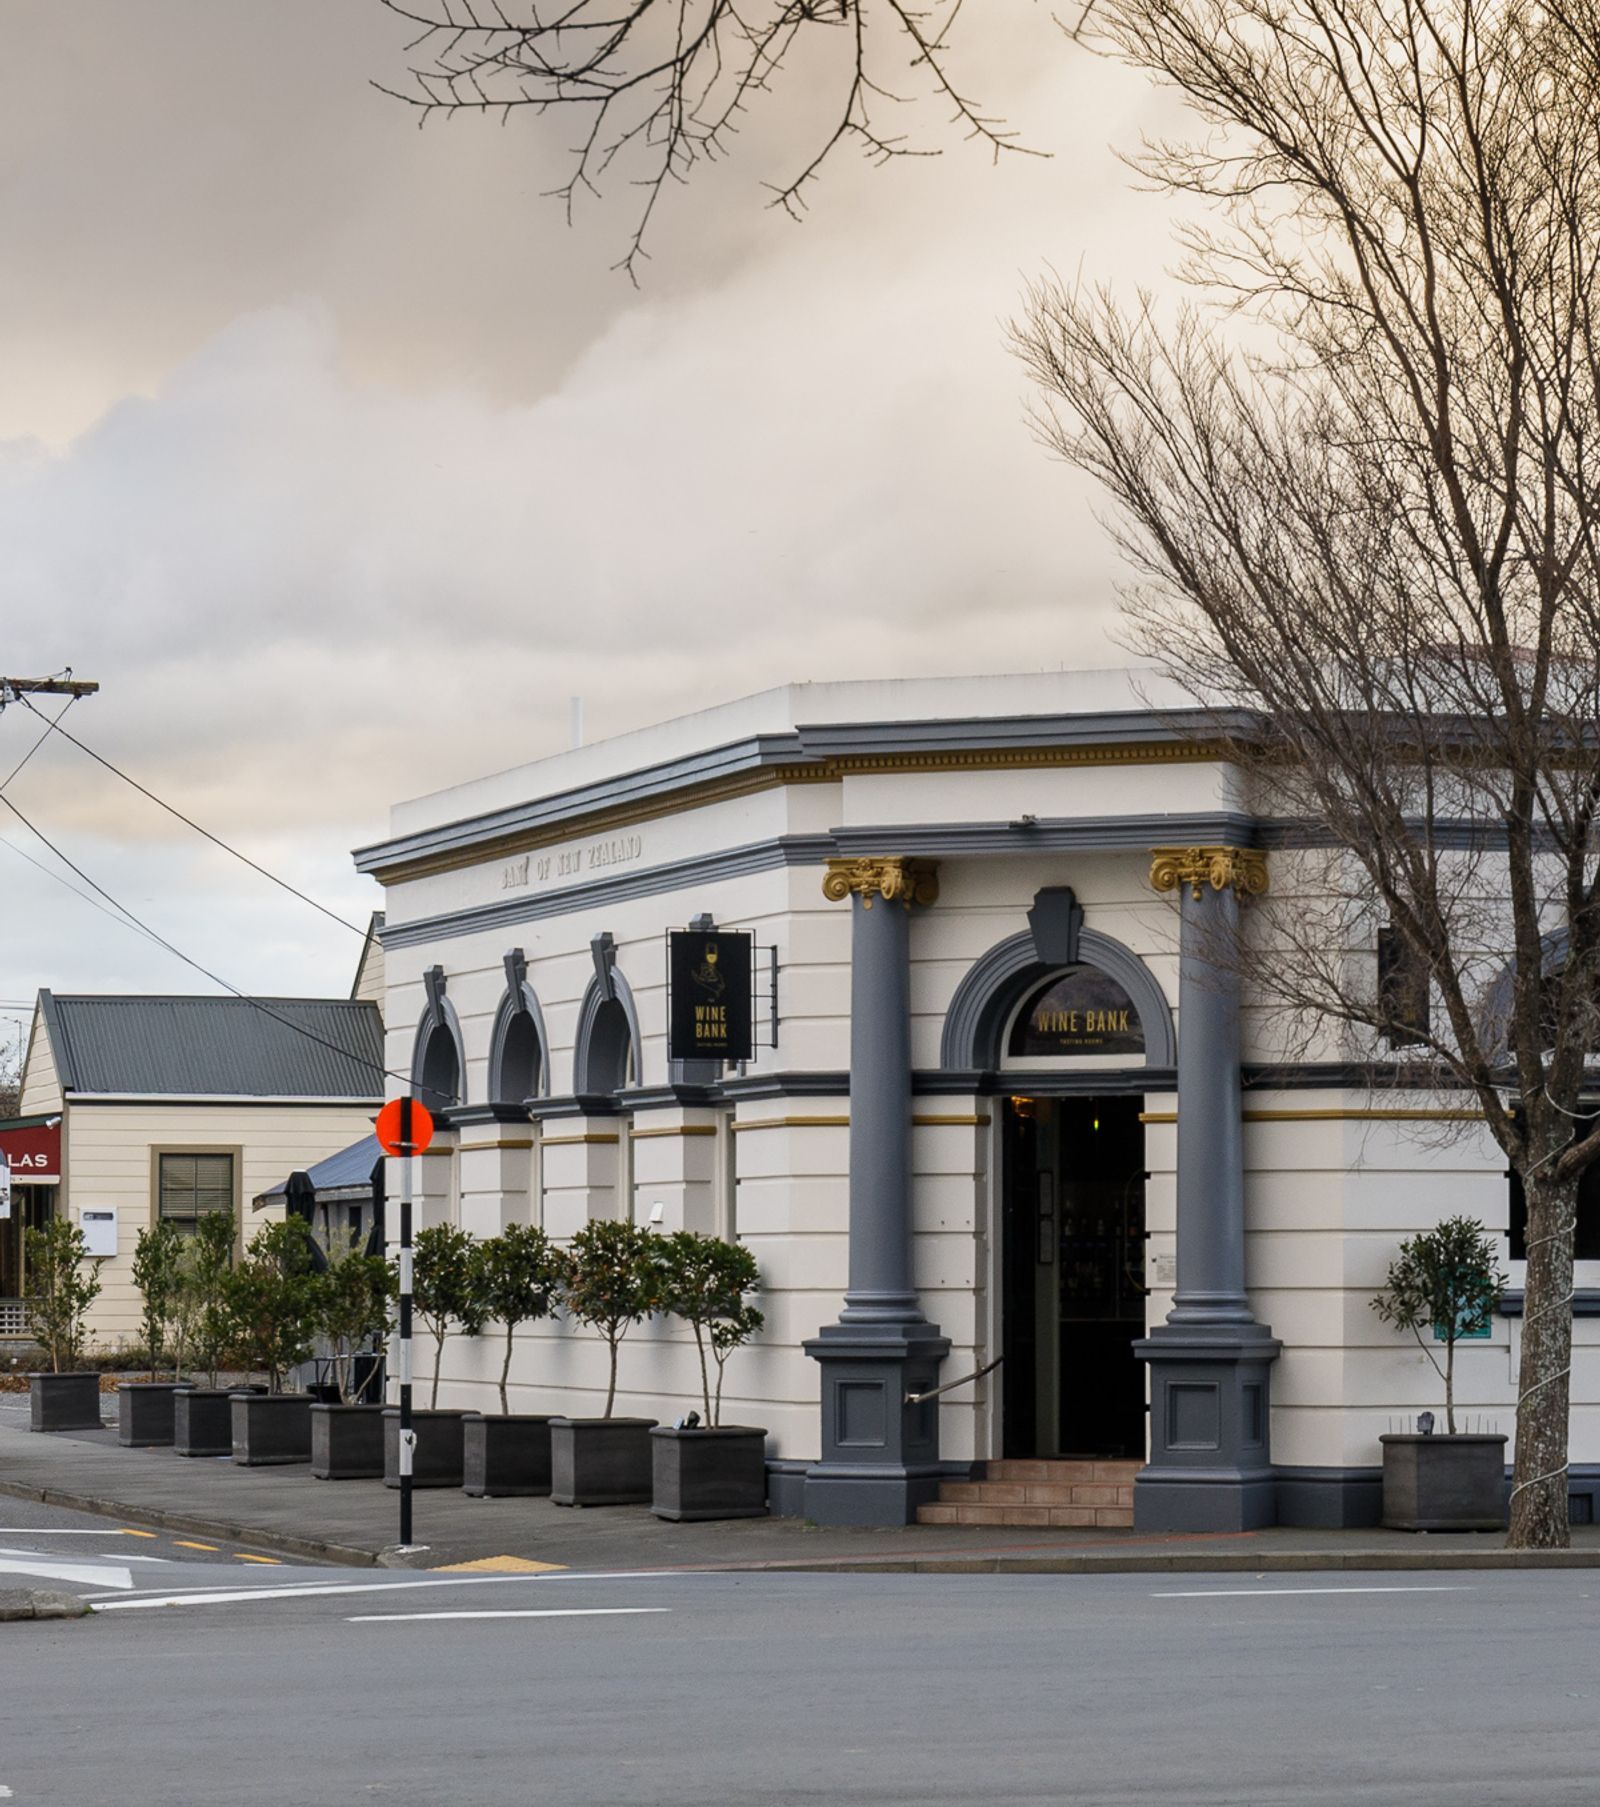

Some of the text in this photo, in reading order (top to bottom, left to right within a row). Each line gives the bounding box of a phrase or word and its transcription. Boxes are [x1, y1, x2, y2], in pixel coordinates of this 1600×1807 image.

[537, 856, 551, 881] OF
[557, 849, 582, 876] NEW
[587, 834, 642, 869] ZEALAND
[695, 1006, 726, 1021] WINE
[1038, 1010, 1128, 1032] WINE BANK
[695, 1023, 727, 1038] BANK
